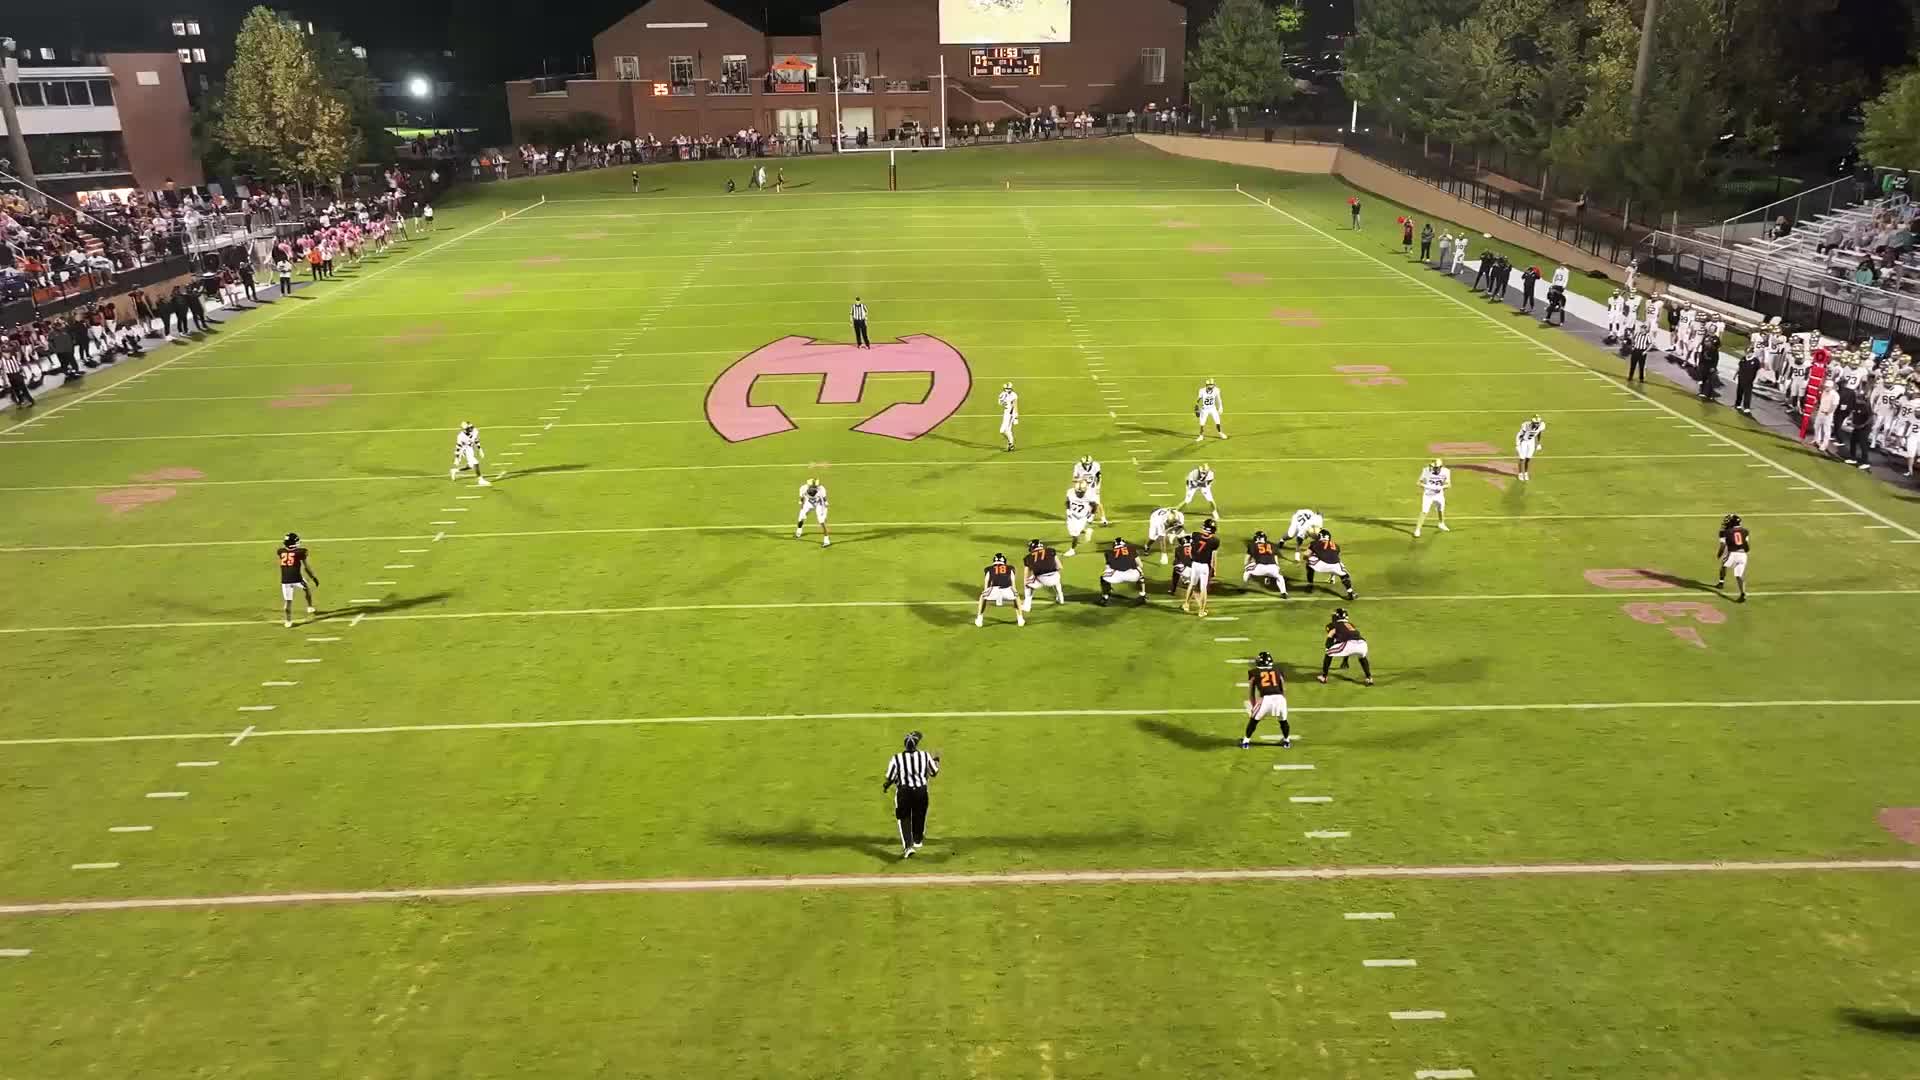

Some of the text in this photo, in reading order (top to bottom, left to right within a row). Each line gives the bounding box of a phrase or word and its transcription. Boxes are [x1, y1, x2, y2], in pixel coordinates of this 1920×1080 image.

[994, 47, 1018, 58] 11:53
[975, 55, 981, 65] 0
[1033, 54, 1040, 64] 0
[992, 66, 1001, 75] 10
[653, 83, 669, 96] 25
[1733, 531, 1744, 546] 0
[1198, 540, 1207, 552] 7
[280, 552, 296, 566] 25
[1031, 549, 1046, 562] 77
[1260, 671, 1279, 687] 21
